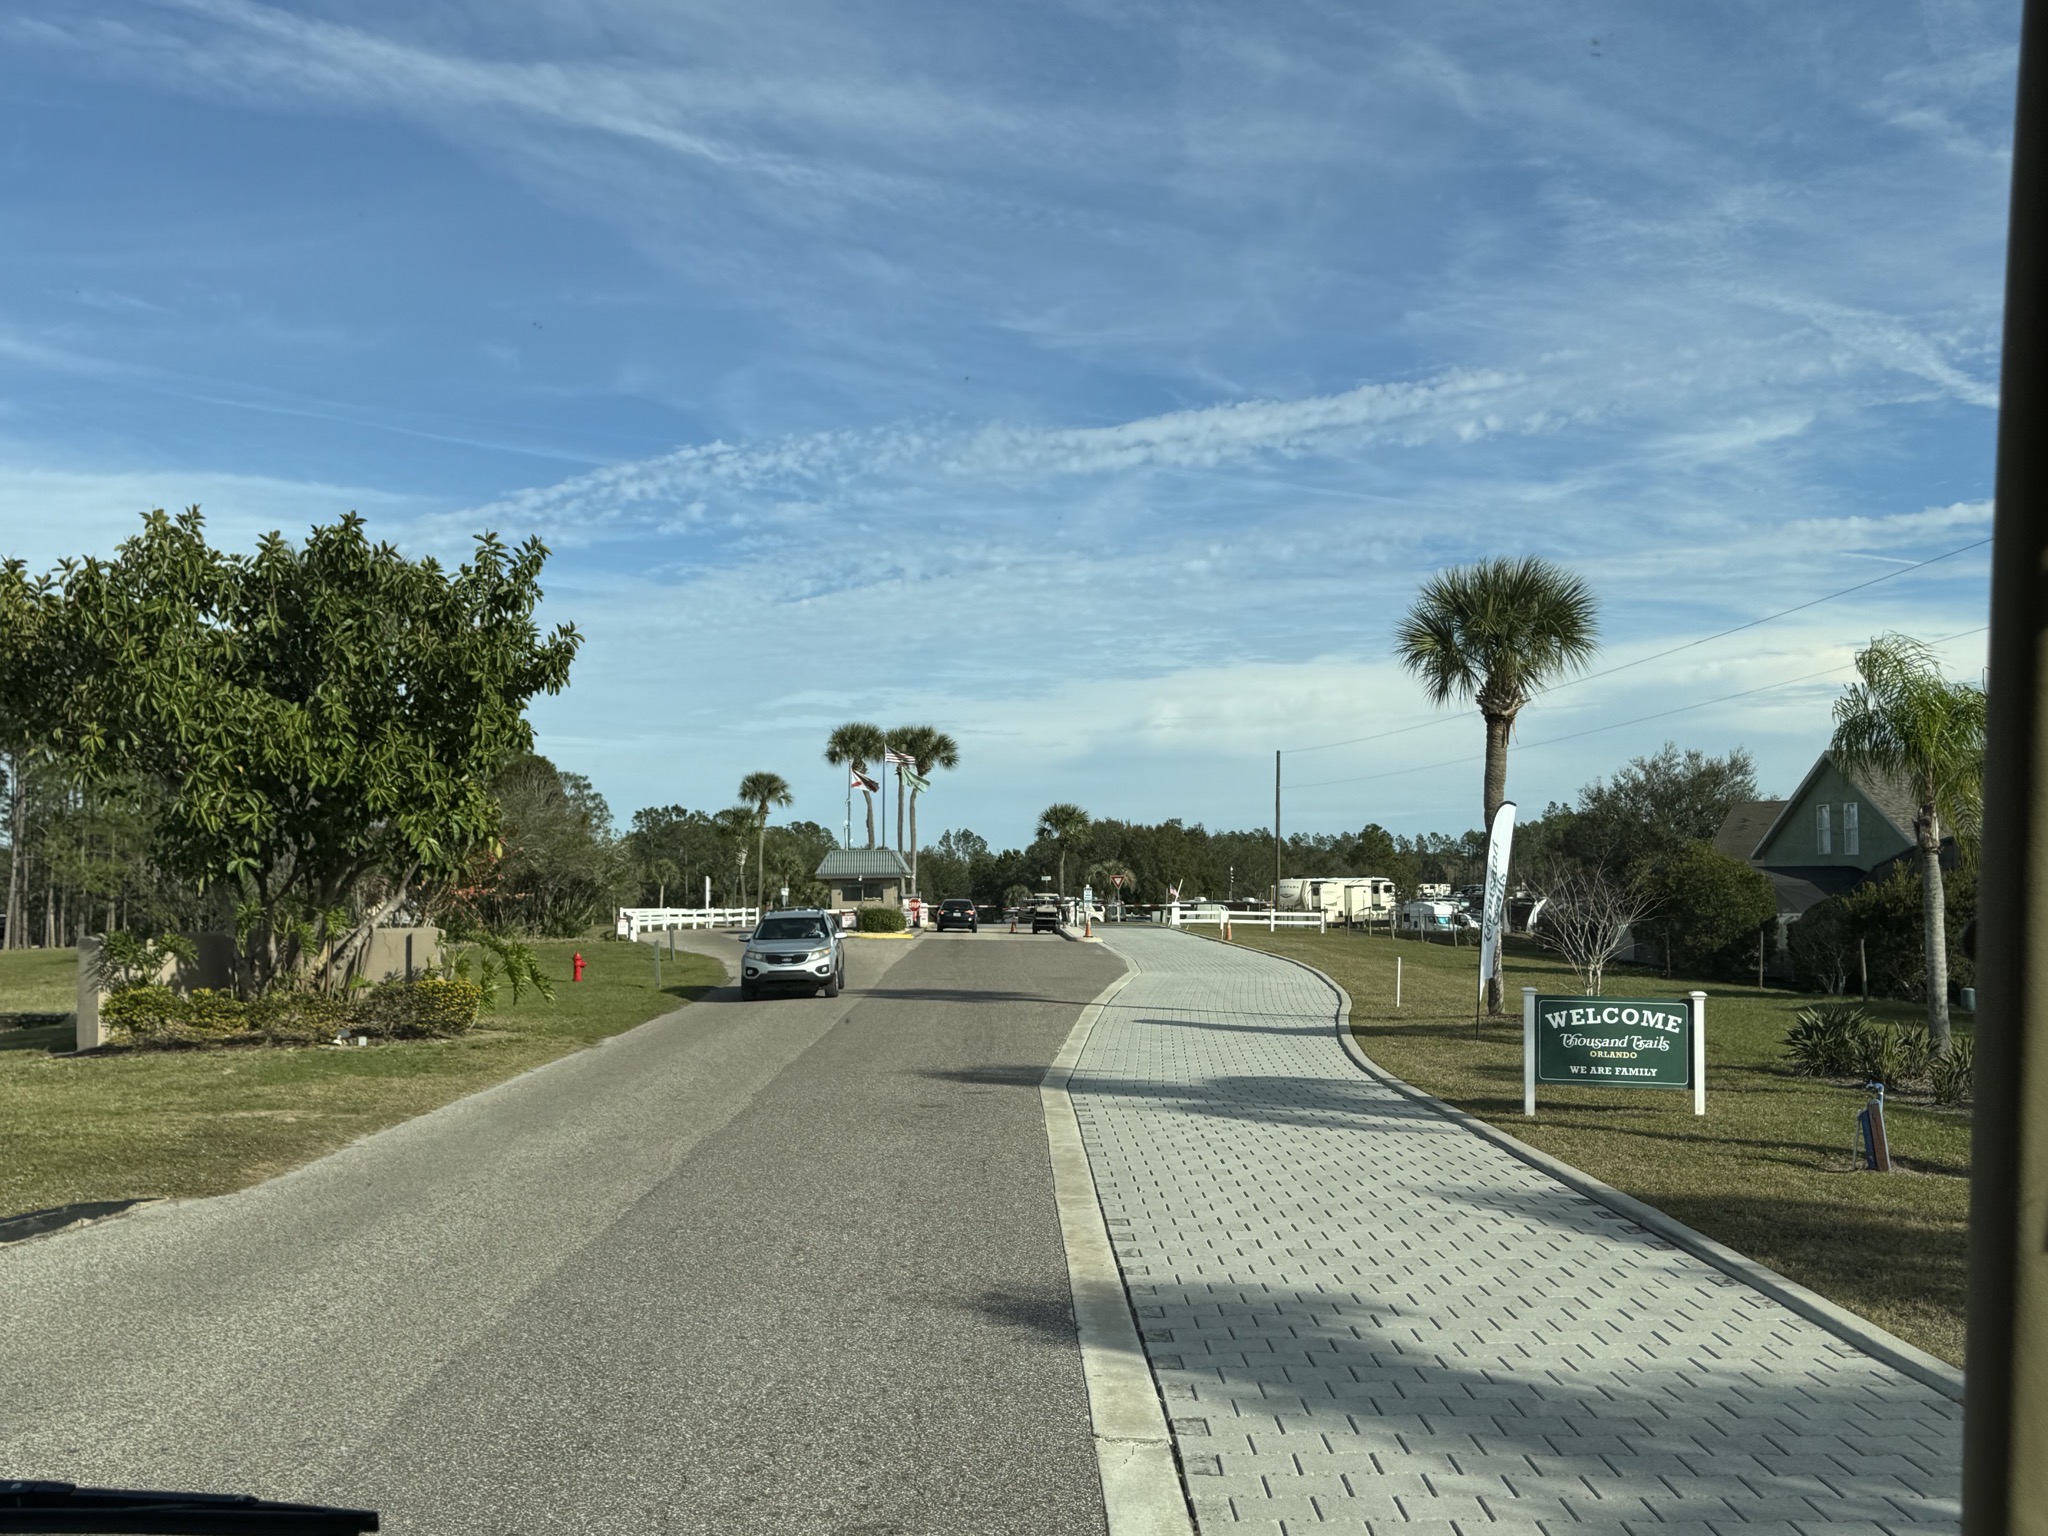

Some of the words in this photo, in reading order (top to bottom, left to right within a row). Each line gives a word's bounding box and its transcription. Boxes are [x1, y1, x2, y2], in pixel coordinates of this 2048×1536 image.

[1483, 839, 1498, 943] Thousand
[1545, 1007, 1683, 1034] WELCOME
[1559, 1033, 1629, 1049] Thousand
[1629, 1035, 1671, 1051] Trails
[1589, 1050, 1638, 1059] ORLANDO
[1569, 1065, 1587, 1074] WE
[1589, 1066, 1612, 1075] ARE
[1614, 1067, 1658, 1077] FAMILY
